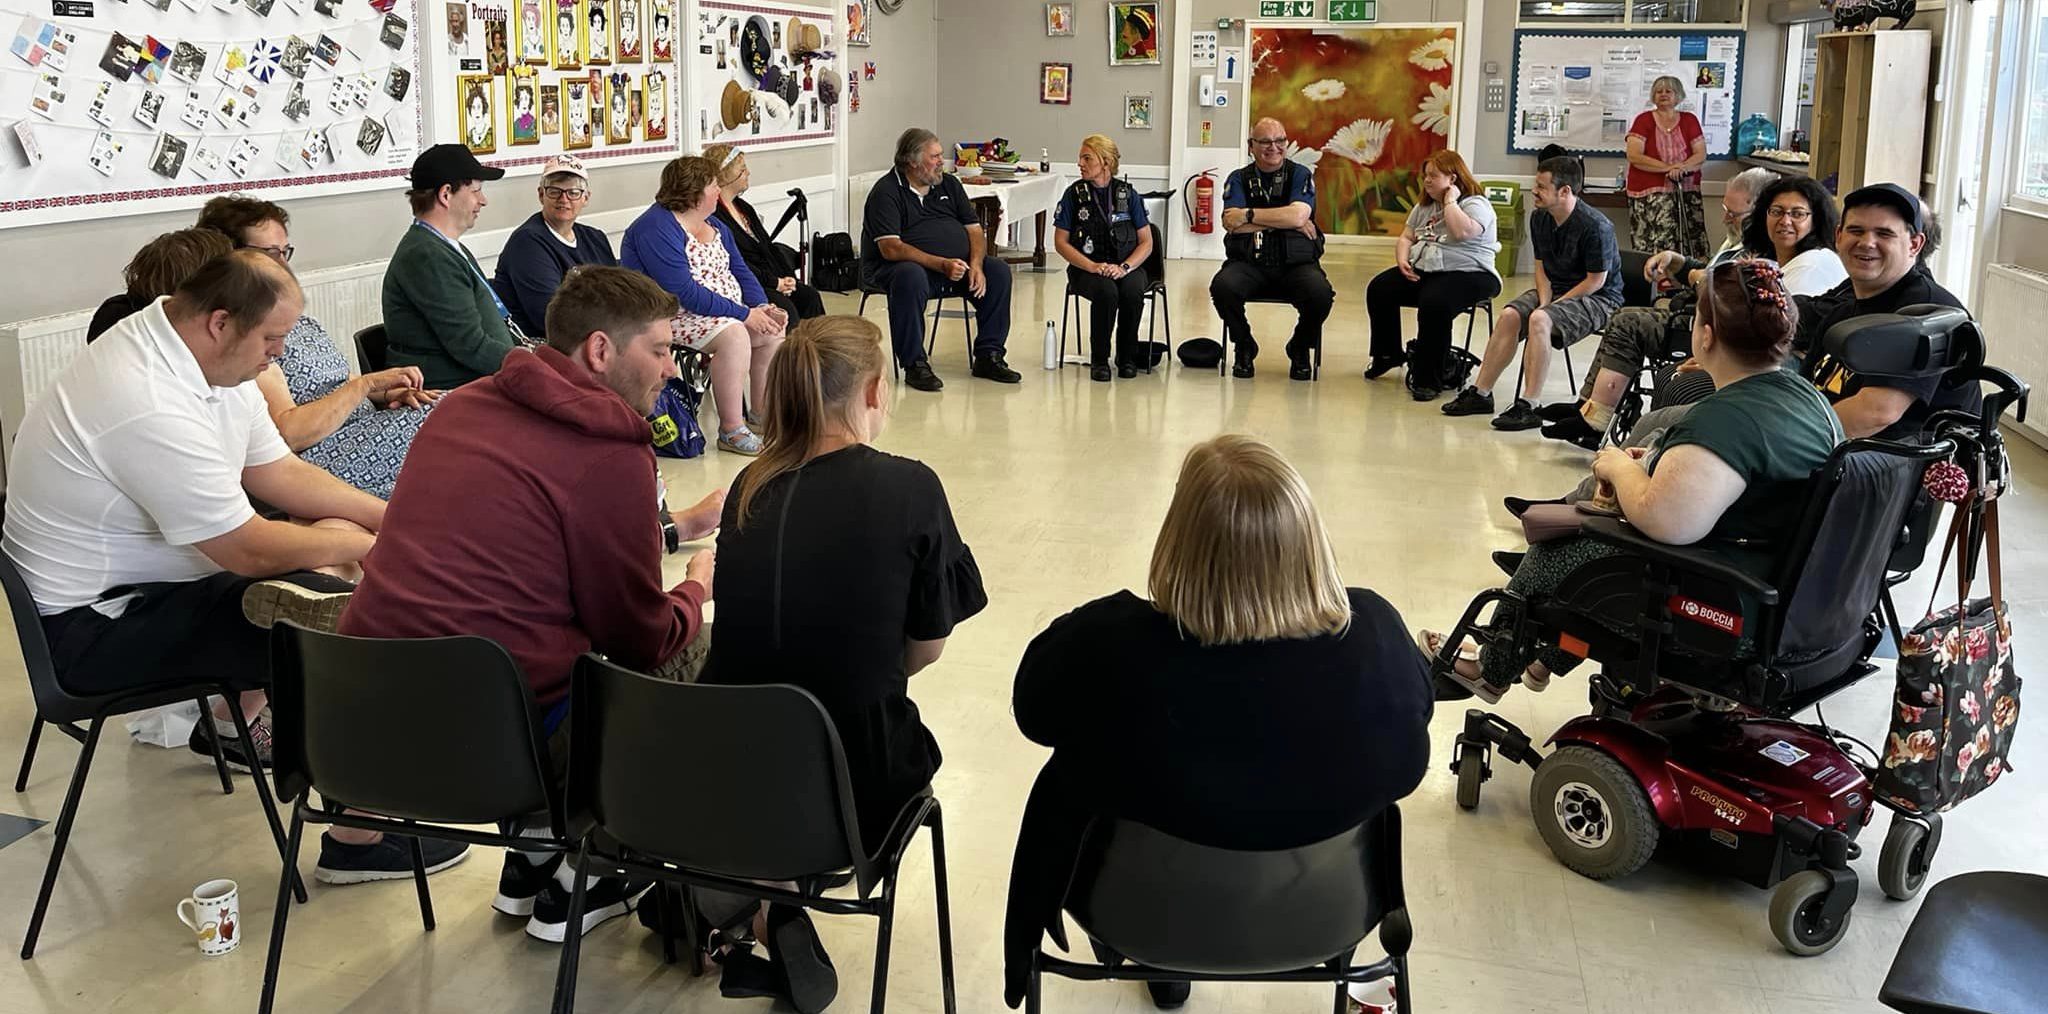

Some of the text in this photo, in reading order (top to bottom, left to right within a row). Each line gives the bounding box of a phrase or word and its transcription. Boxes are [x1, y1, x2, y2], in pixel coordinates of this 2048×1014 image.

[471, 3, 508, 23] Portraits
[1263, 1, 1278, 9] Fire
[1680, 600, 1686, 610] I
[1699, 607, 1735, 628] BOCCIA
[1690, 785, 1747, 821] PRONTO
